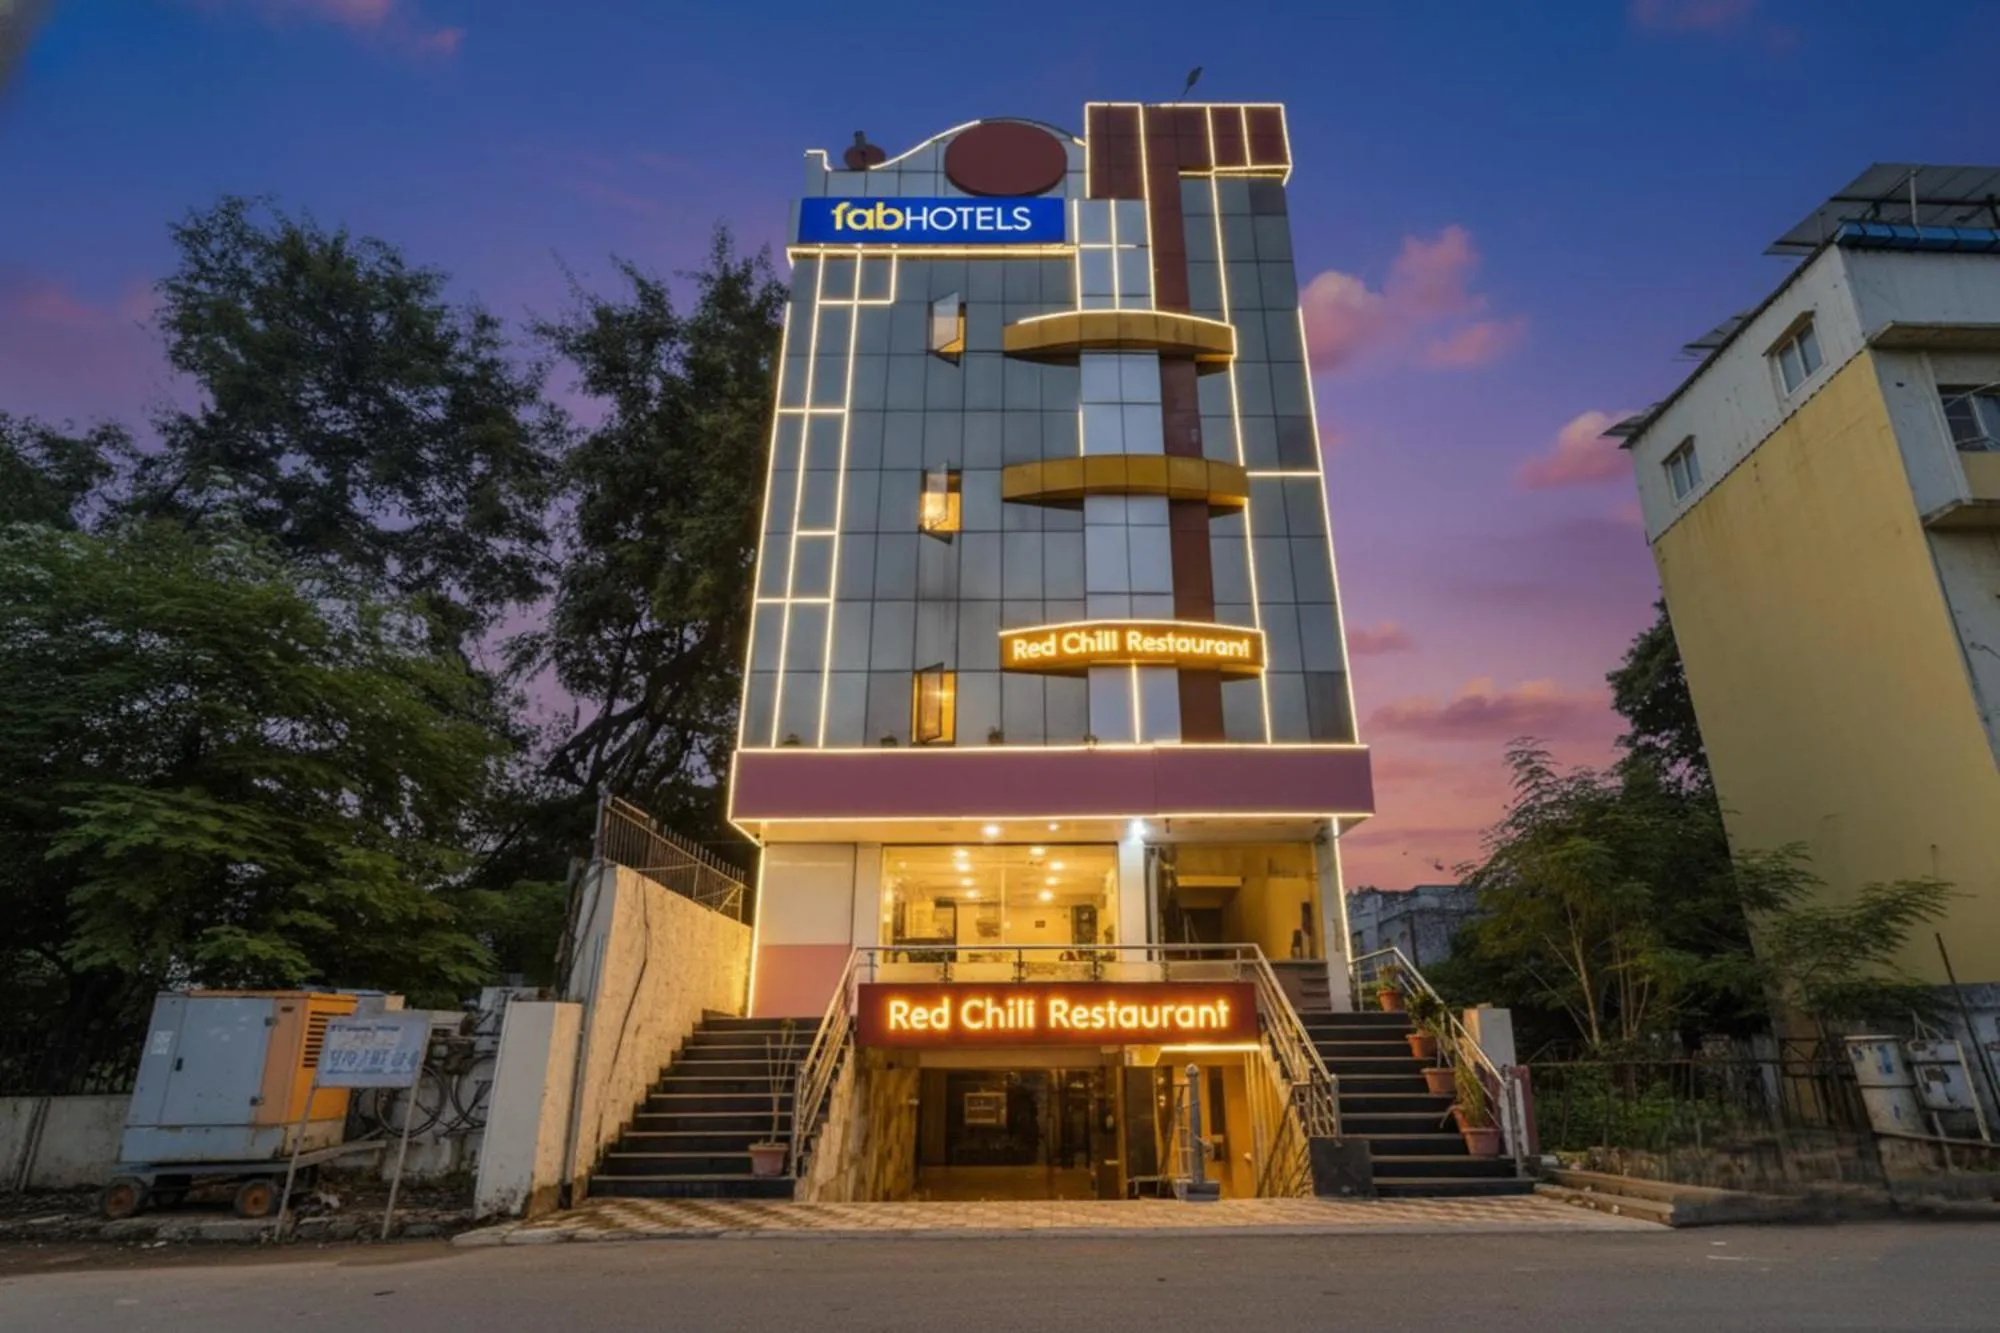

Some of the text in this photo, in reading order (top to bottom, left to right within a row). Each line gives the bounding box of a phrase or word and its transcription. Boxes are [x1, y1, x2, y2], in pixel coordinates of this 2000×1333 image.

[831, 201, 1032, 231] fabHOTELS
[1013, 634, 1057, 660] Red
[1126, 630, 1250, 658] Restaurant
[888, 997, 1230, 1031] Red Chili Restaurant
